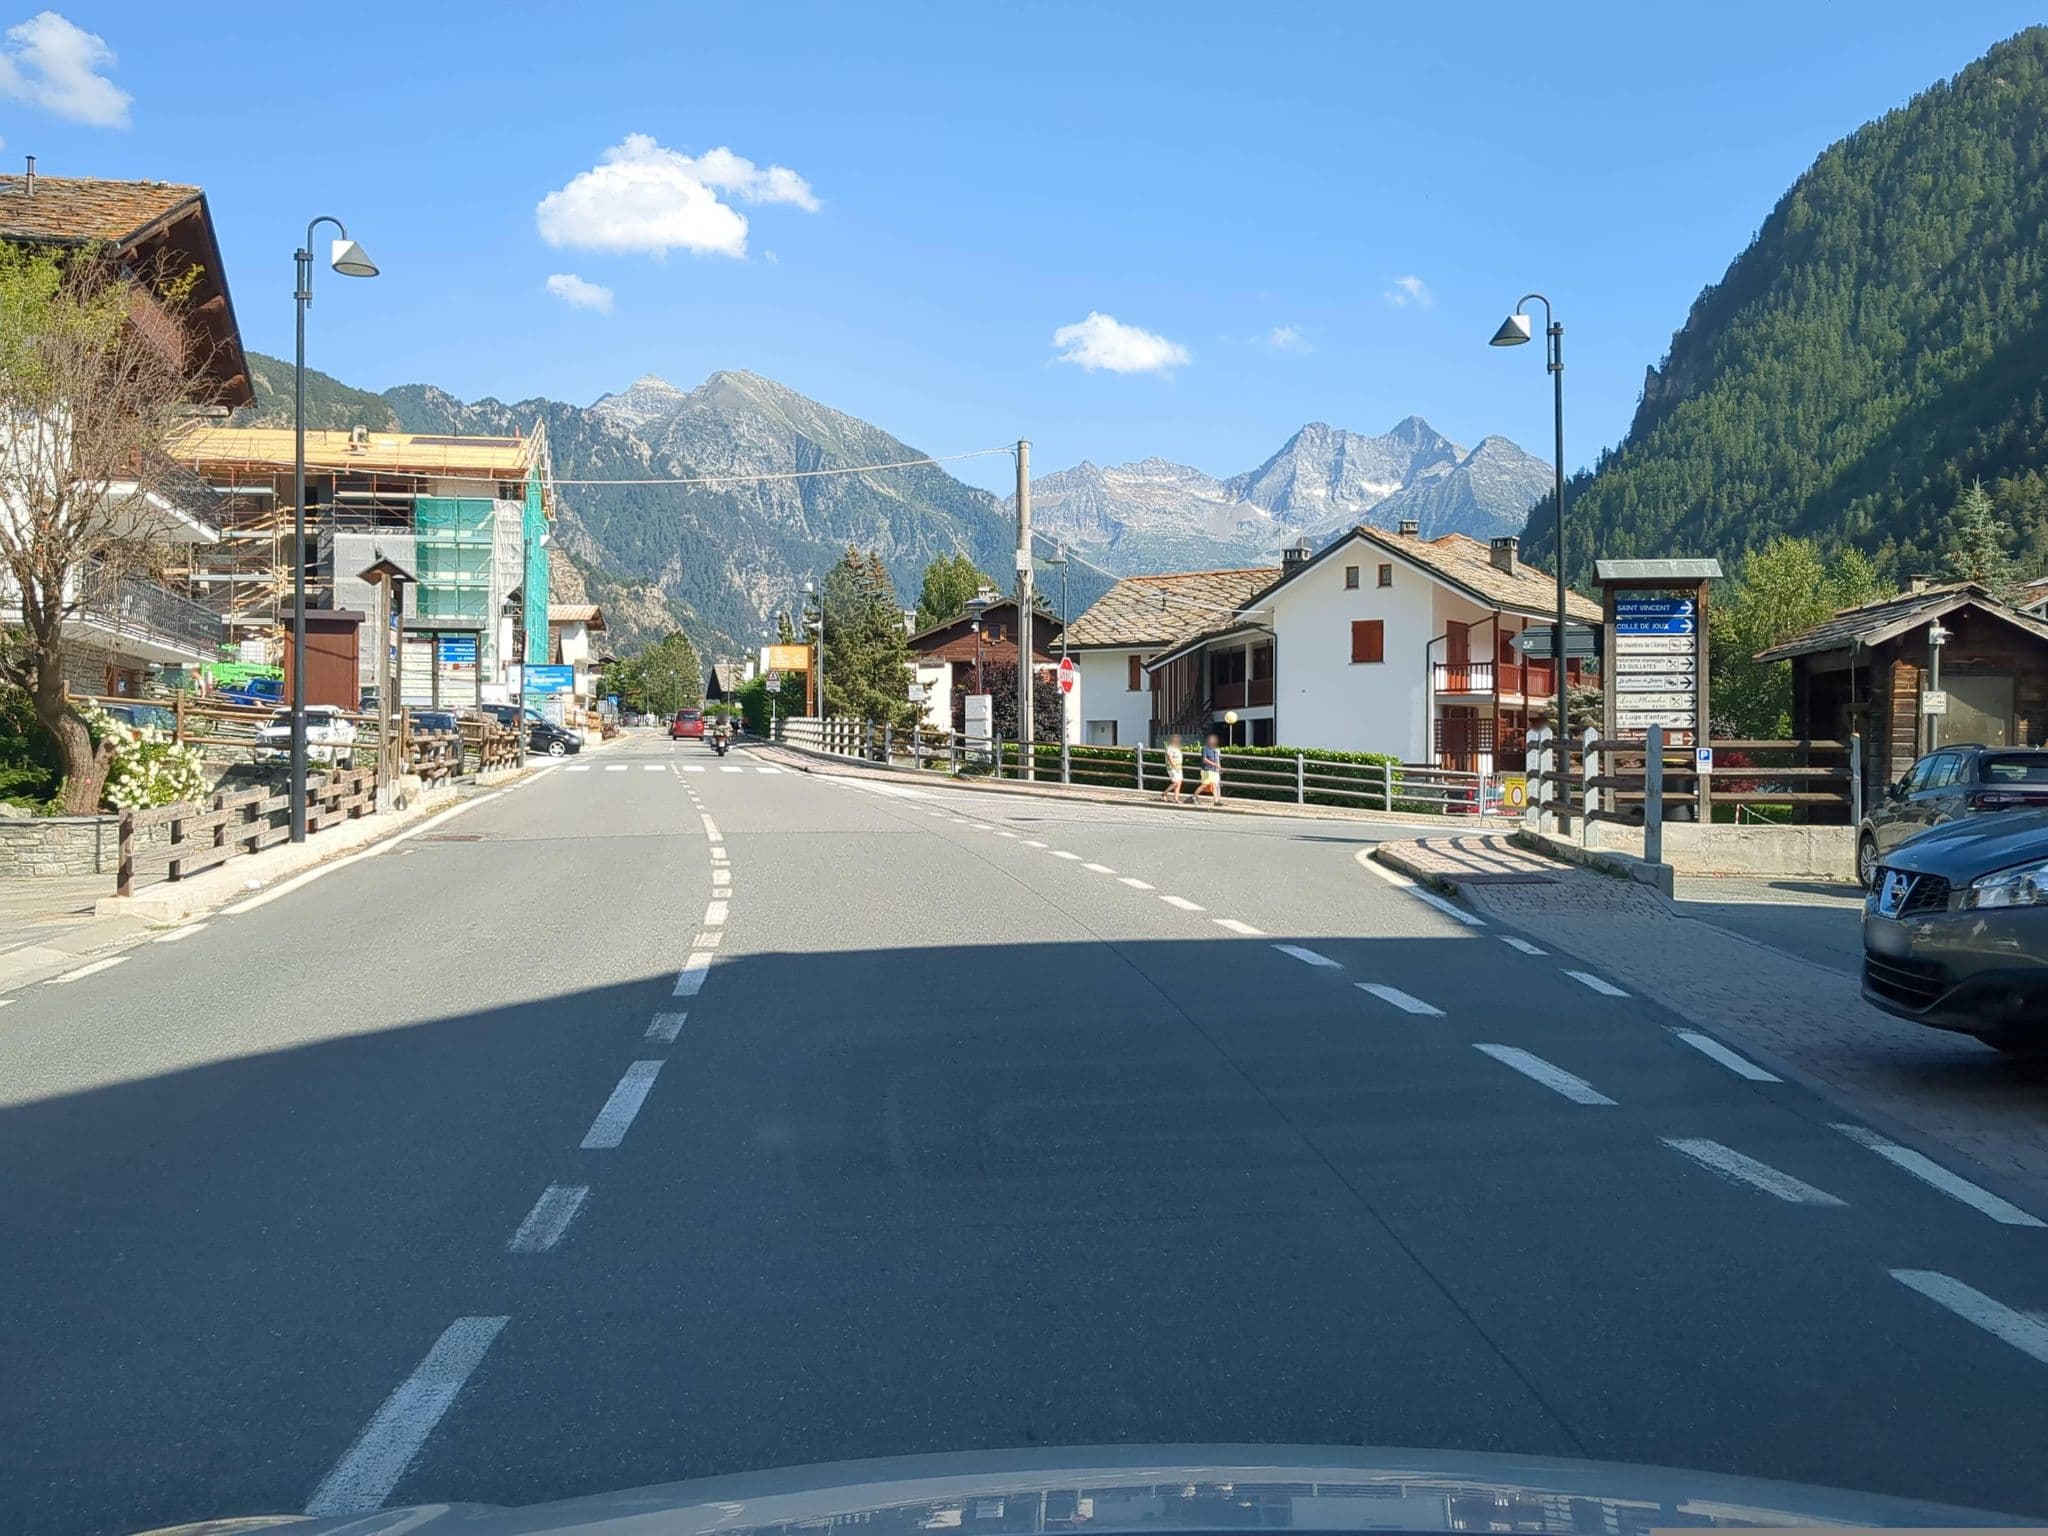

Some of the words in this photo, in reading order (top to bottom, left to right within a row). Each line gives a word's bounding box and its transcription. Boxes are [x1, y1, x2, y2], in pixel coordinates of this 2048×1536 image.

[1617, 604, 1638, 612] SAINT
[1639, 604, 1671, 612] VINCENT
[1060, 669, 1073, 681] STOP
[1701, 751, 1708, 760] P
